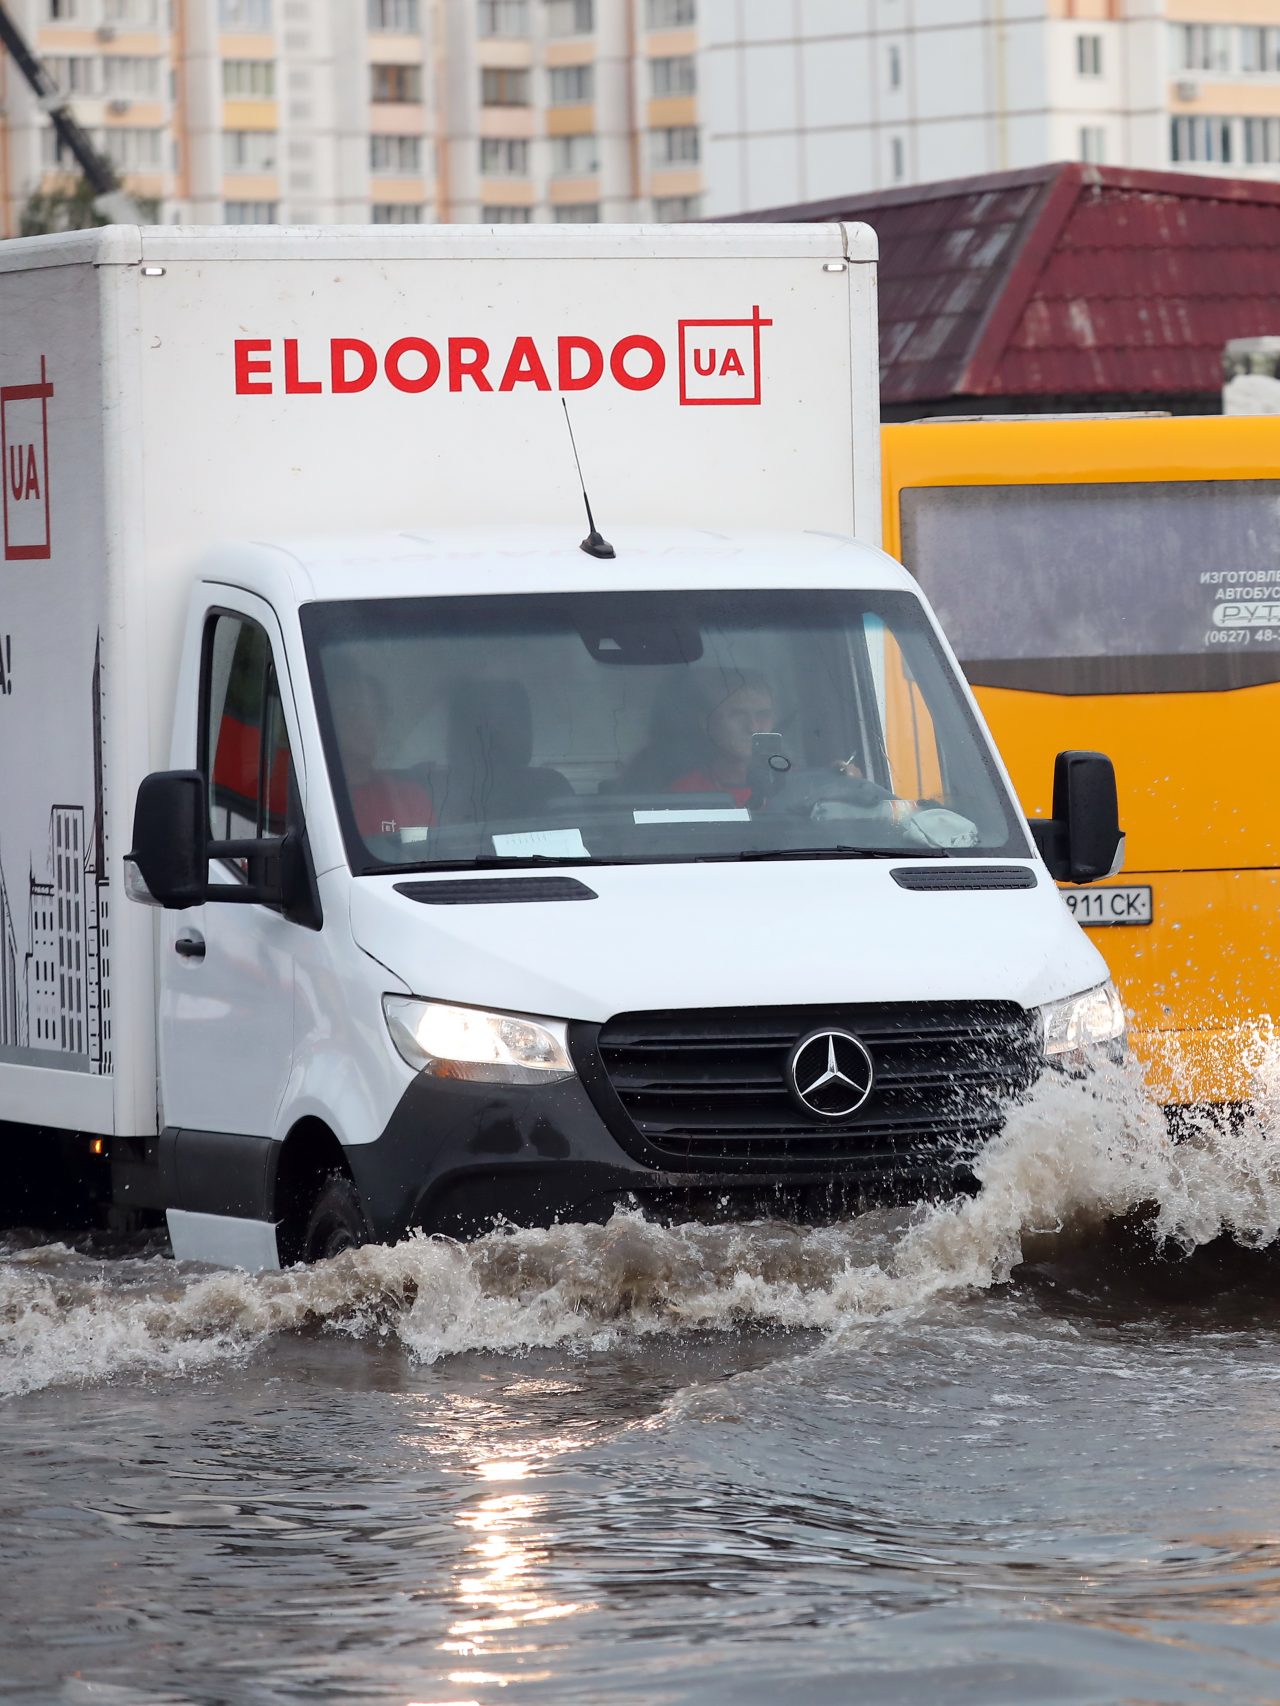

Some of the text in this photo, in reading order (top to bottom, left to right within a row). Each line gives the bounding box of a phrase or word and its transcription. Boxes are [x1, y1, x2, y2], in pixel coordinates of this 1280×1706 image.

[234, 334, 666, 395] ELDORADO
[693, 347, 746, 377] UA
[9, 444, 40, 501] UA
[1204, 630, 1250, 646] (0627)
[1111, 893, 1142, 915] CK
